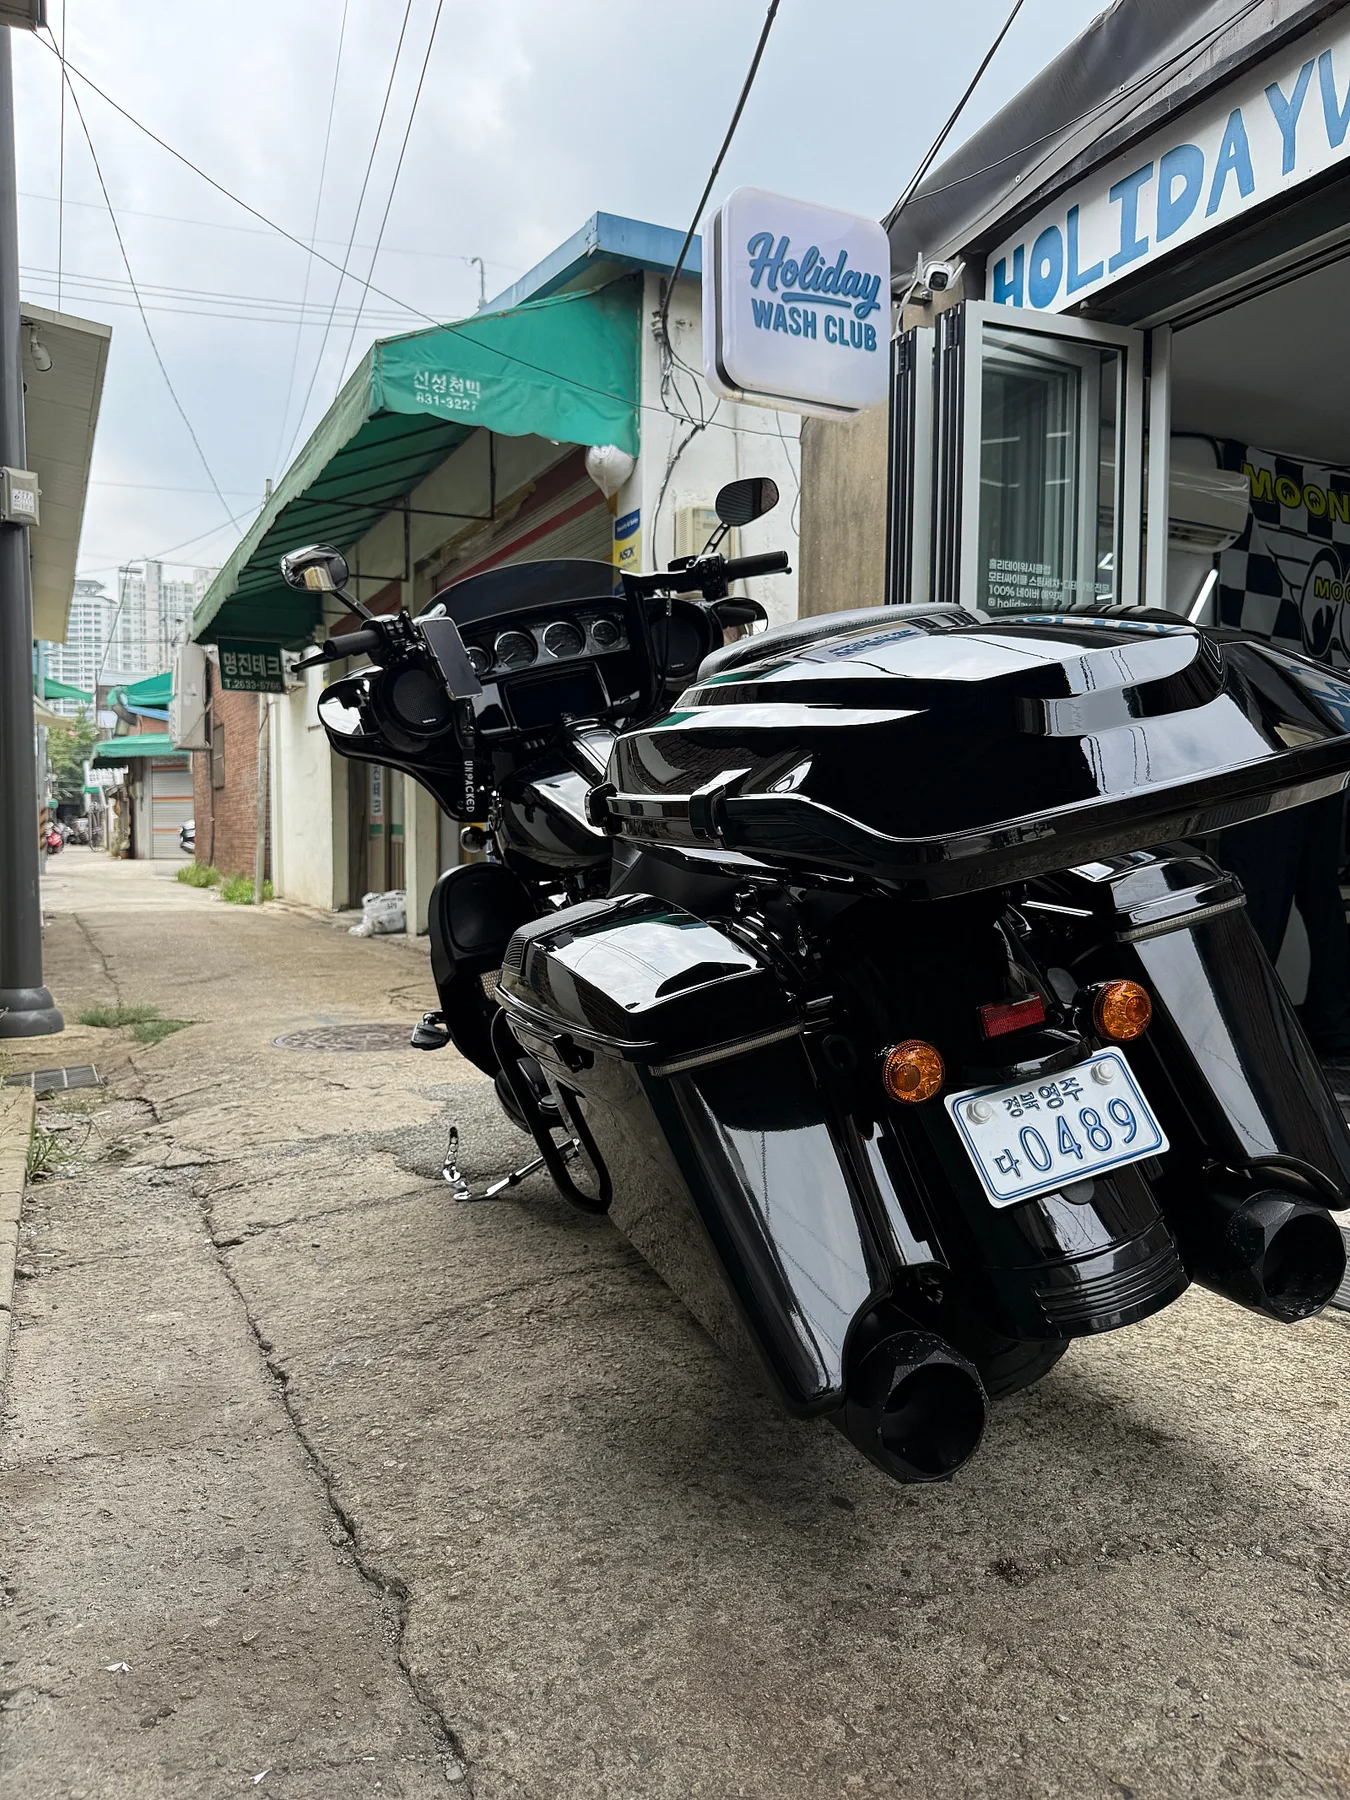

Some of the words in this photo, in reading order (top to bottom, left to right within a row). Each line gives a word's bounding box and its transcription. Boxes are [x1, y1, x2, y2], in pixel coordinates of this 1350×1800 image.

[747, 231, 882, 320] Holiday
[751, 298, 817, 340] WASH
[824, 314, 878, 352] CLUB
[416, 391, 478, 412] 831-3227
[987, 571, 1028, 586] 모터싸이클
[988, 558, 1051, 575] 홀리데이워시클럽
[988, 584, 1015, 597] 100%
[1016, 587, 1040, 600] 네이버
[223, 652, 282, 677] 명진테크
[464, 760, 475, 813] UNPACKED
[1003, 1076, 1084, 1118] 경북영주
